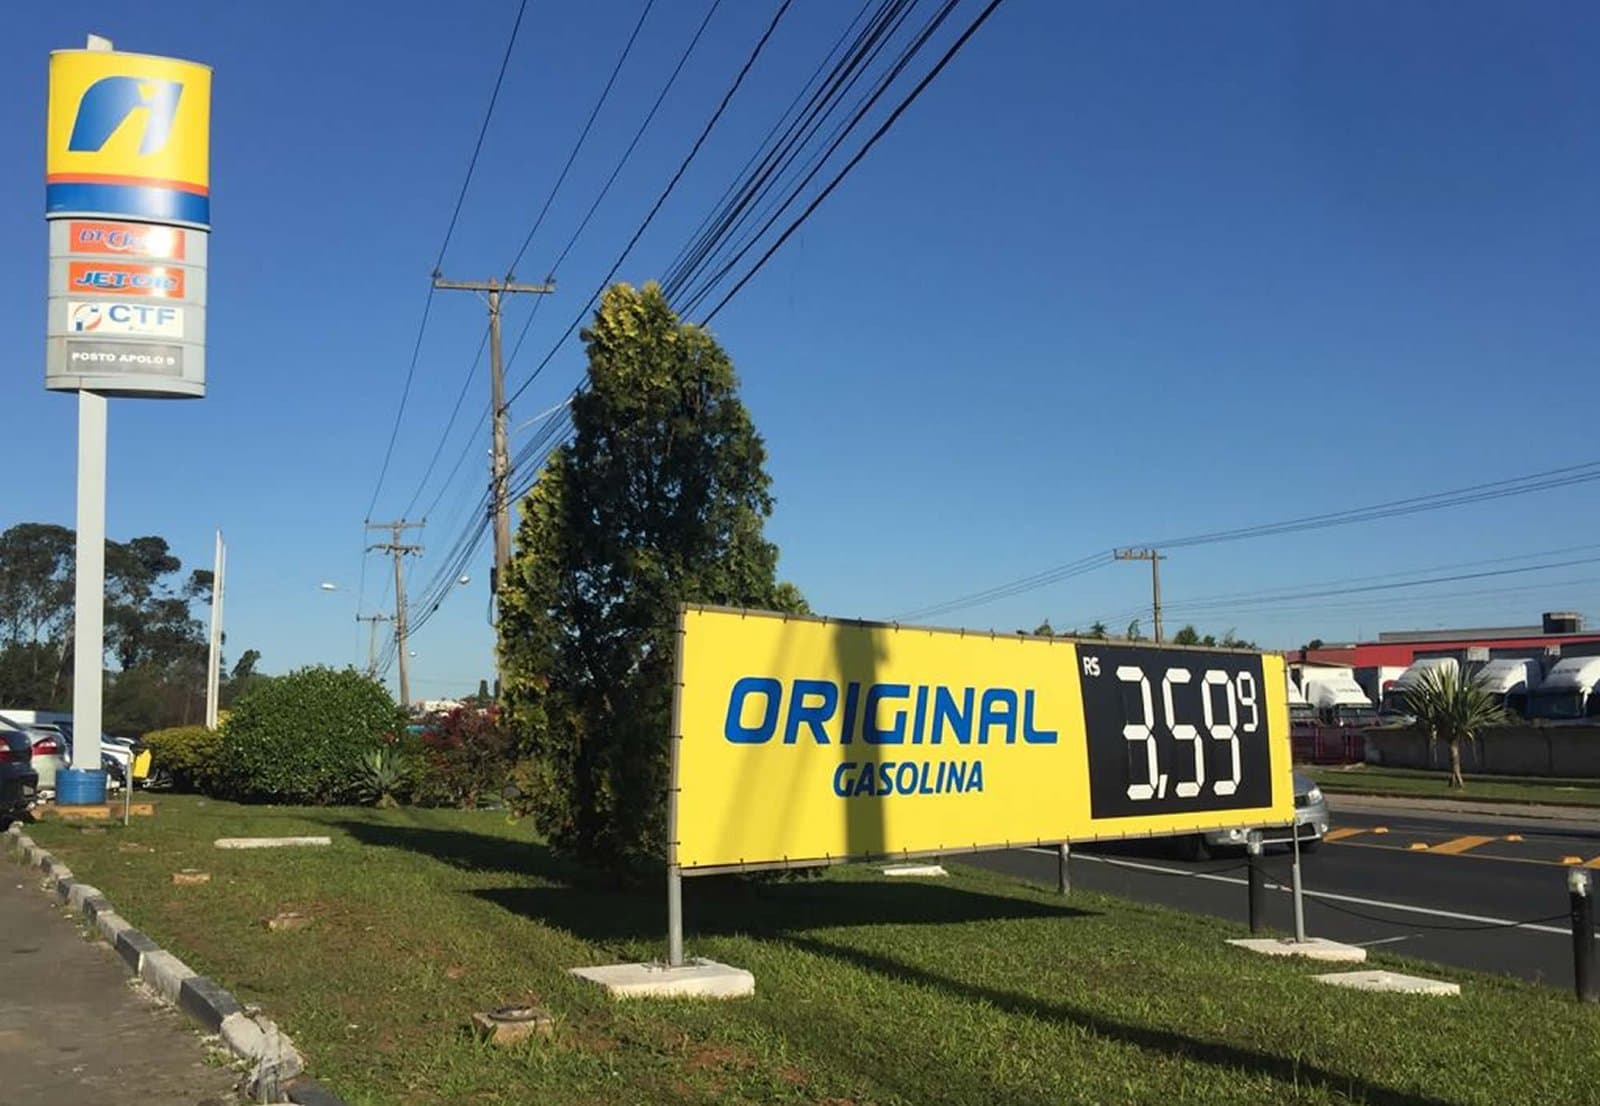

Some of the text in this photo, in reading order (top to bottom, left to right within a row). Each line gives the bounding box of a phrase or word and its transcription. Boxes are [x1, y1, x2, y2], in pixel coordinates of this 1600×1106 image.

[76, 271, 127, 286] JET
[108, 304, 176, 325] CTF
[71, 352, 117, 362] POSTO
[118, 354, 164, 365] APOLO
[724, 677, 1058, 745] ORIGINAL
[833, 760, 983, 798] GASOLINA
